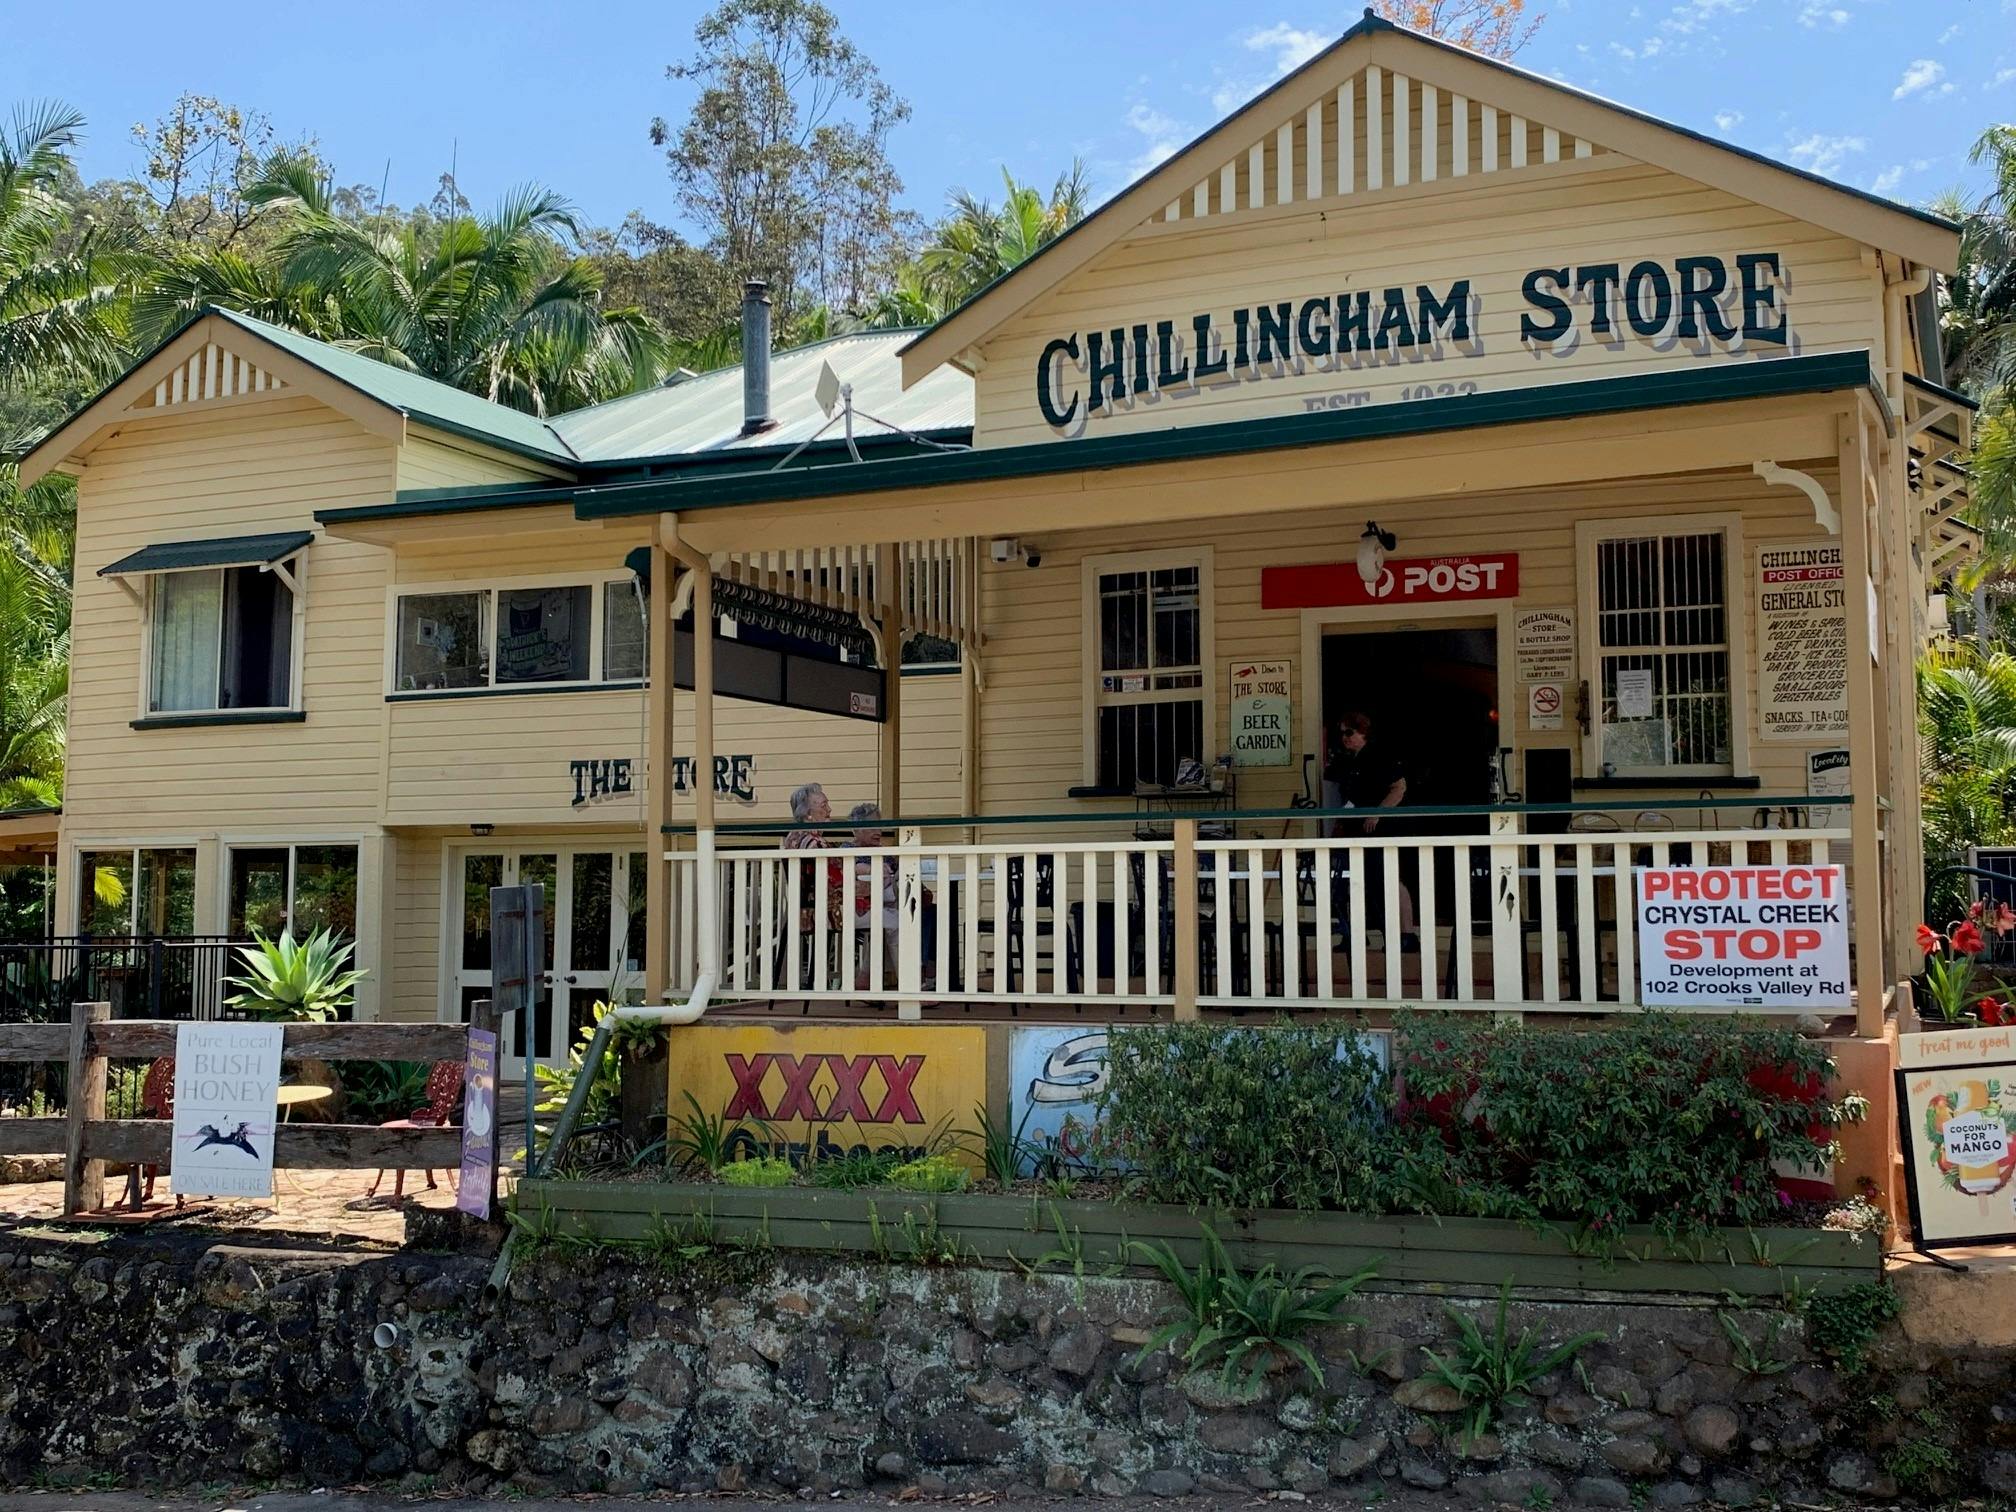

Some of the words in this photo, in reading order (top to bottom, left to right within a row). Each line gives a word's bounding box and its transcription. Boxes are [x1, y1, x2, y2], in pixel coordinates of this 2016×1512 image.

[1036, 280, 1474, 428] CHILLINGHAM
[1519, 251, 1789, 348] STORE
[1430, 558, 1471, 566] AUSTRALIA
[1761, 549, 1843, 569] CHILLINGH
[1404, 562, 1504, 594] POST
[1768, 570, 1802, 581] POST
[1761, 591, 1822, 611] GENERAL
[1518, 612, 1572, 629] CHILLINGHAM
[1532, 624, 1557, 633] STORE
[1768, 620, 1809, 630] WINES
[1526, 636, 1551, 644] BOTTLE
[1768, 630, 1797, 641] COLD
[1796, 629, 1822, 640] BEER
[1774, 640, 1801, 650] SOFT
[1804, 639, 1846, 649] DRINKS
[1763, 651, 1801, 661] BREAD
[1261, 663, 1276, 674] Down
[1766, 661, 1801, 672] DAIRY
[1778, 670, 1845, 681] GROCERIES
[1234, 682, 1252, 698] THE
[1257, 681, 1288, 695] STORE
[1773, 681, 1848, 692] SMALLGOODS
[1773, 691, 1842, 702] VEGETABLES
[1243, 714, 1281, 730] BEER
[1235, 734, 1287, 750] GARDEN
[1813, 755, 1850, 770] Locality
[570, 758, 632, 808] THE
[1644, 868, 1839, 901] PROTECT
[1645, 905, 1751, 924] CRYSTAL
[1758, 904, 1840, 923] CREEK
[1664, 929, 1822, 960] STOP
[1670, 964, 1793, 979] Development
[1799, 964, 1819, 977] at
[1646, 981, 1679, 994] 102
[1685, 981, 1752, 994] Crooks
[1758, 981, 1813, 997] Valley
[1819, 981, 1845, 994] Rd
[187, 1033, 225, 1048] Pure
[230, 1031, 272, 1049] Local
[1918, 1036, 1951, 1057] treat
[1955, 1038, 1975, 1050] me
[1978, 1032, 2010, 1057] good
[194, 1054, 262, 1075] BUSH
[183, 1079, 271, 1101] HONEY
[724, 1053, 927, 1124] XXXX
[1911, 1076, 1933, 1096] NEW
[1950, 1123, 1999, 1134] COCONUTS
[1964, 1133, 1986, 1142] FOR
[1950, 1140, 2002, 1154] MANGO
